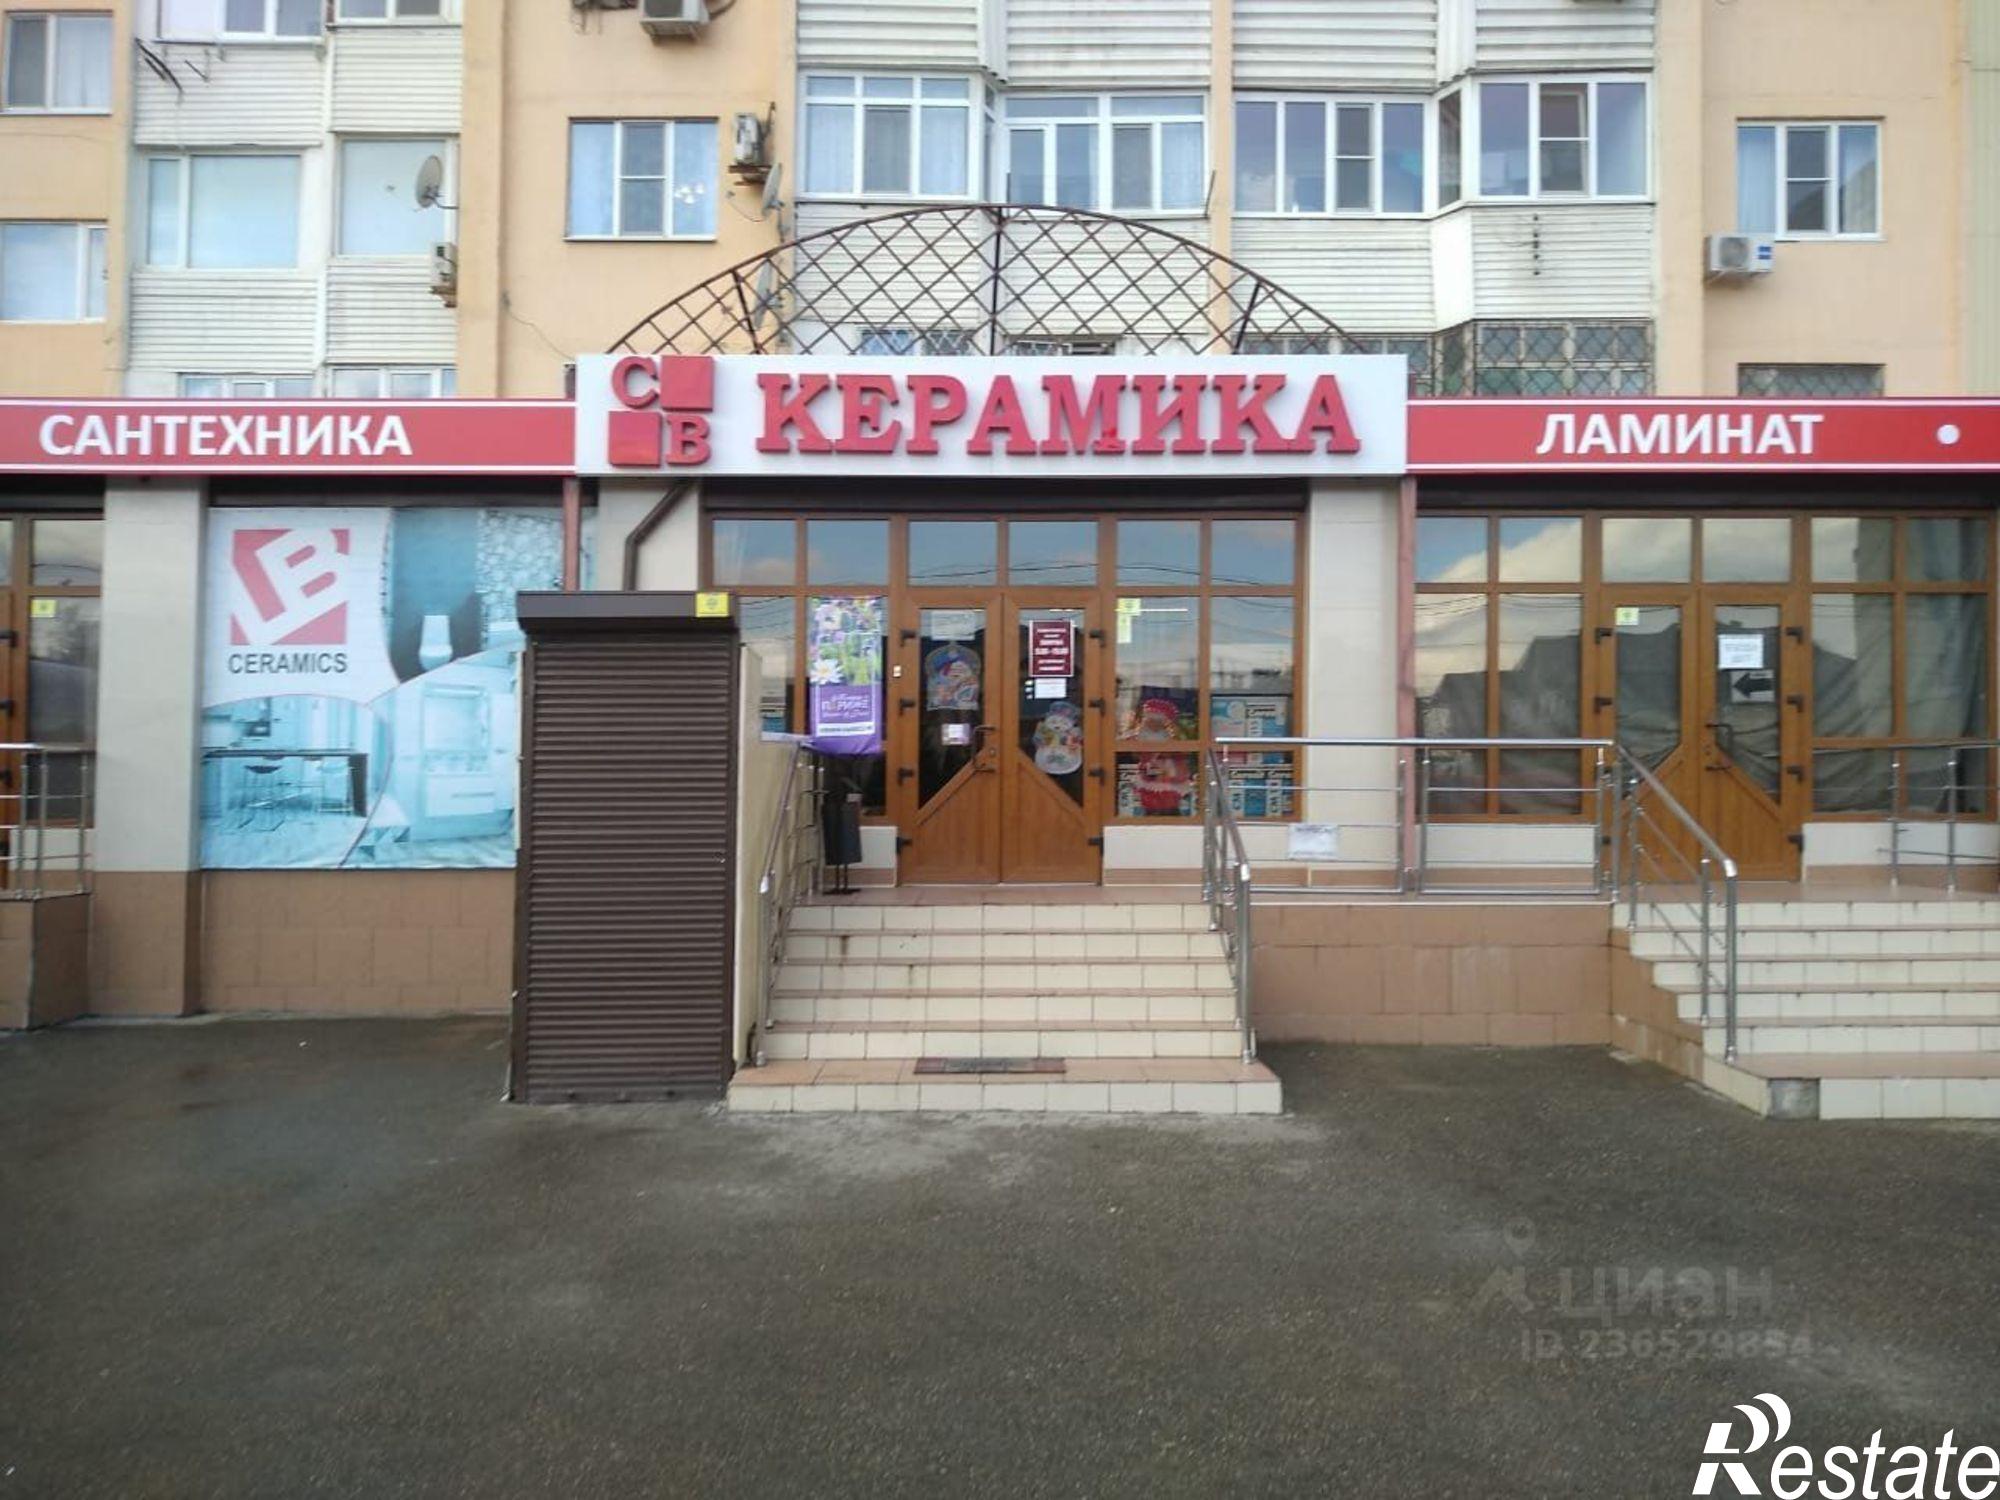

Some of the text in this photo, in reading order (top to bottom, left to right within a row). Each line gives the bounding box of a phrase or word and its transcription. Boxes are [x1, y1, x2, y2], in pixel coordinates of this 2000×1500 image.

[39, 413, 413, 456] САНТЕХНИКА
[756, 373, 1361, 454] КЕРАМИКА
[1536, 413, 1824, 455] ЛАМИНАТ
[228, 653, 348, 673] CERAMICS
